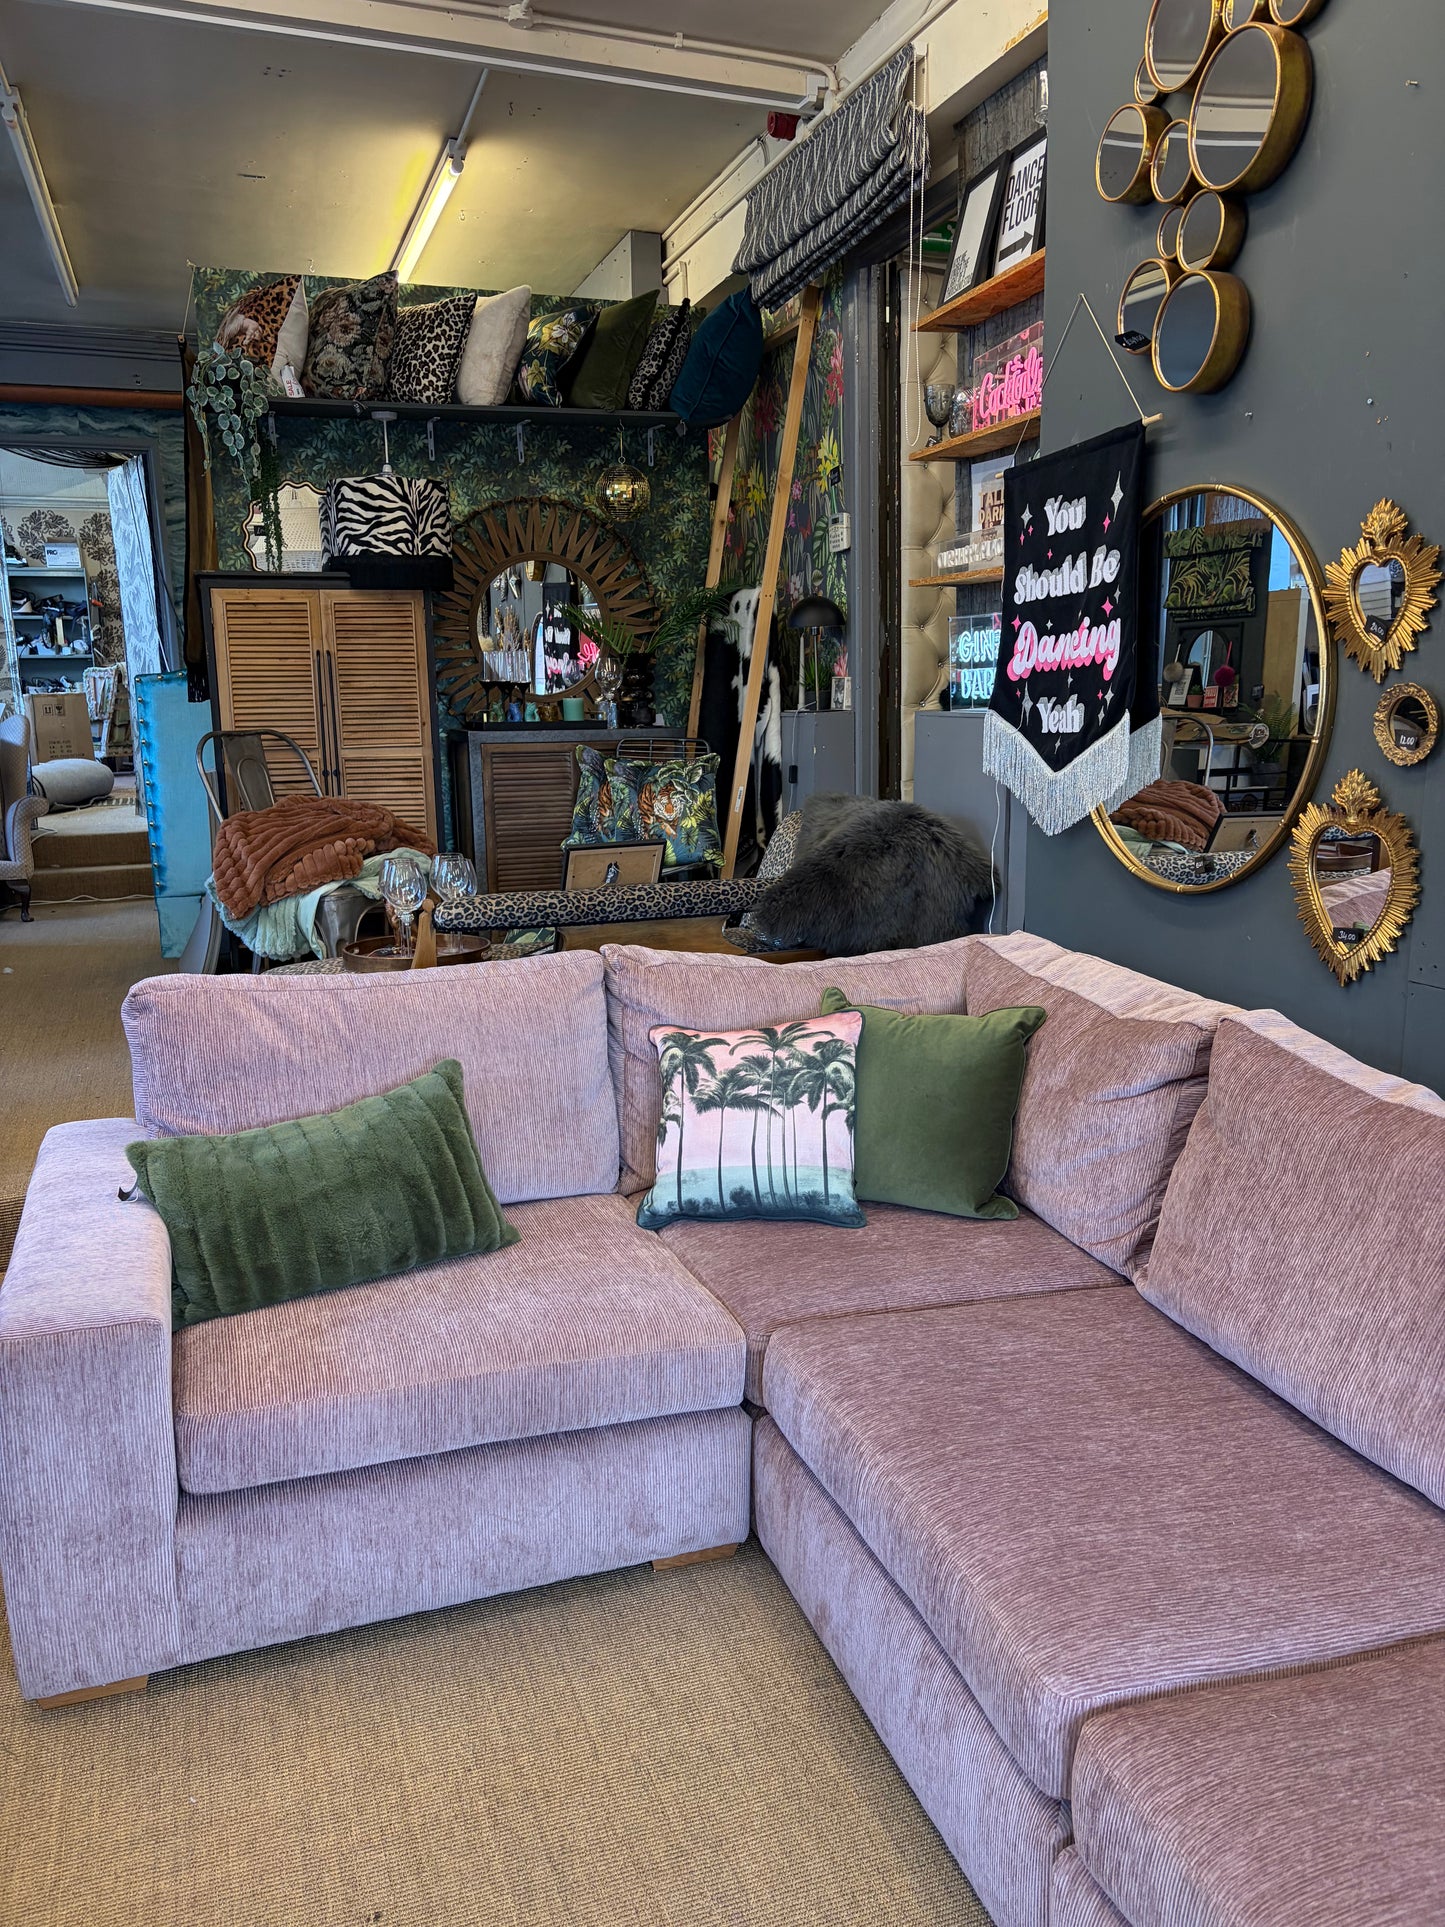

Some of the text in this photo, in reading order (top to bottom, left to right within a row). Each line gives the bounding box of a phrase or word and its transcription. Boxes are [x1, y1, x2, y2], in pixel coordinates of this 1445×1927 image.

[1006, 156, 1045, 203] DANCE
[1002, 186, 1040, 236] FLOOR
[1043, 495, 1087, 536] You
[1013, 544, 1121, 605] Should Be
[958, 629, 995, 663] GIN
[1007, 616, 1121, 681] Dancing
[960, 667, 996, 700] BAR
[1036, 694, 1085, 733] Yeah
